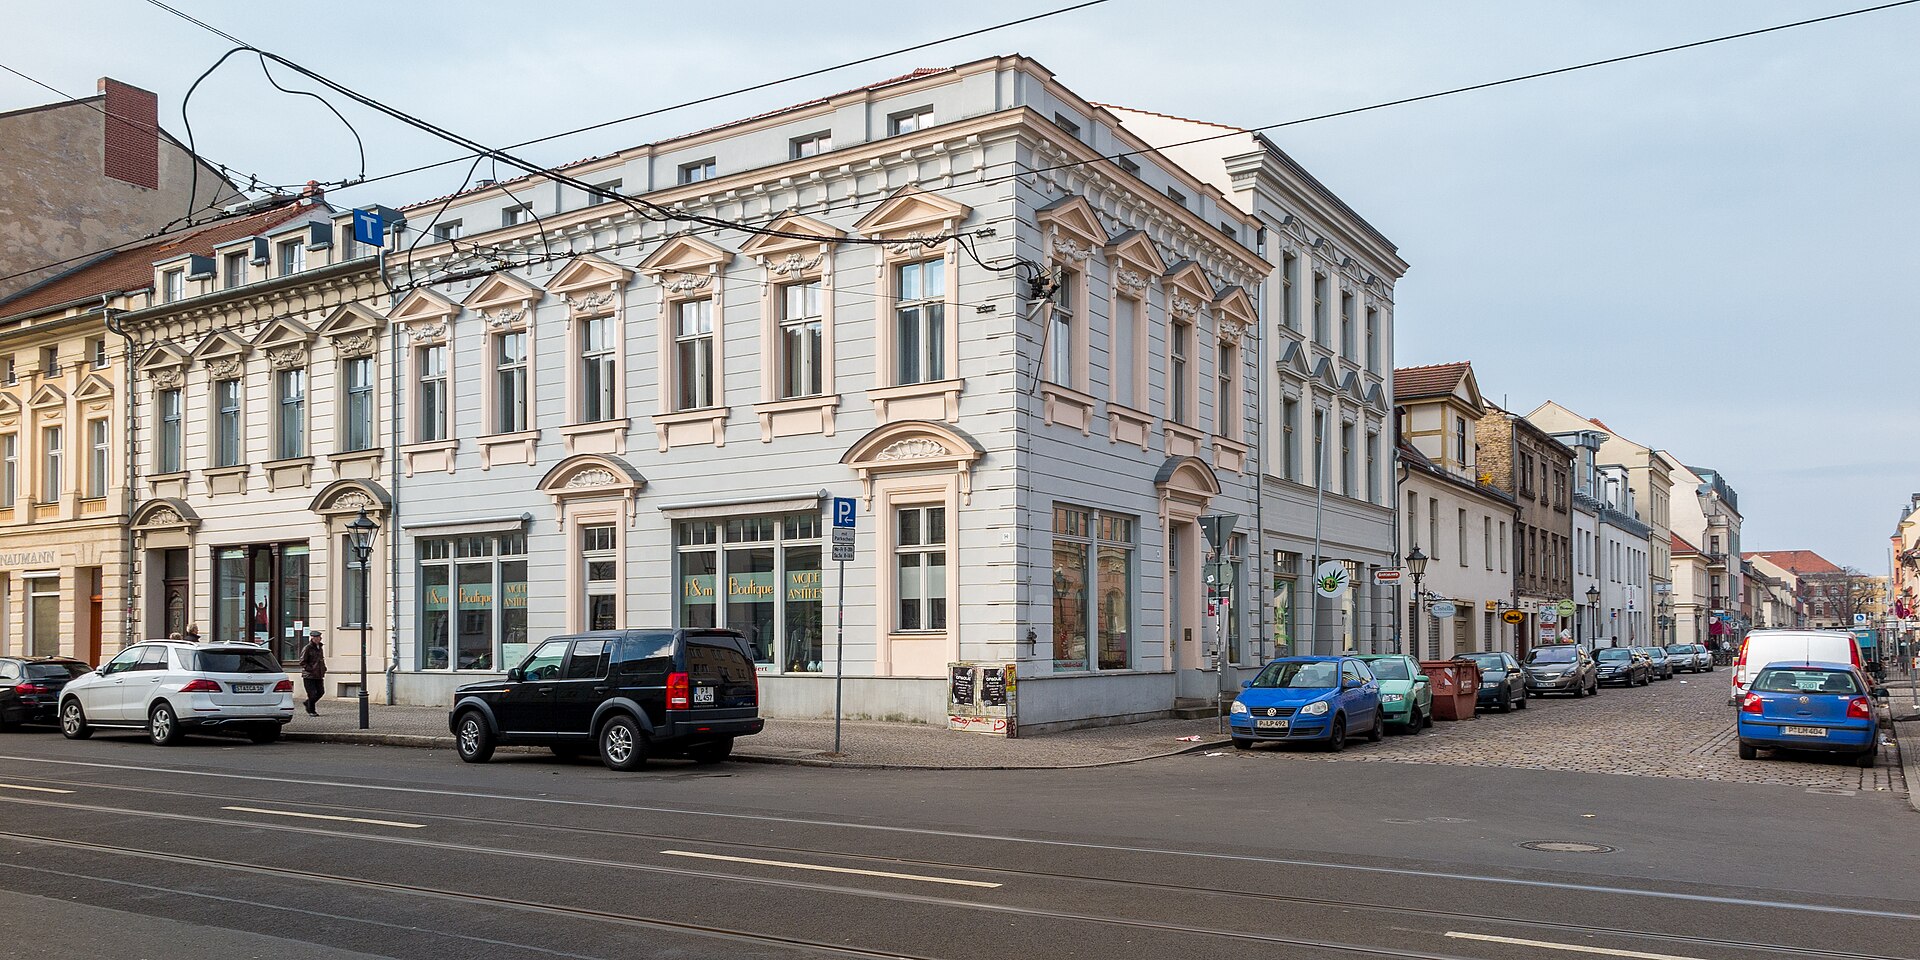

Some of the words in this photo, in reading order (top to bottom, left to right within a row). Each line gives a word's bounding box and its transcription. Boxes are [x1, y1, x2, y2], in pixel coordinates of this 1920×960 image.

[838, 501, 851, 524] P
[728, 576, 774, 598] Boutique
[792, 572, 820, 584] MODE
